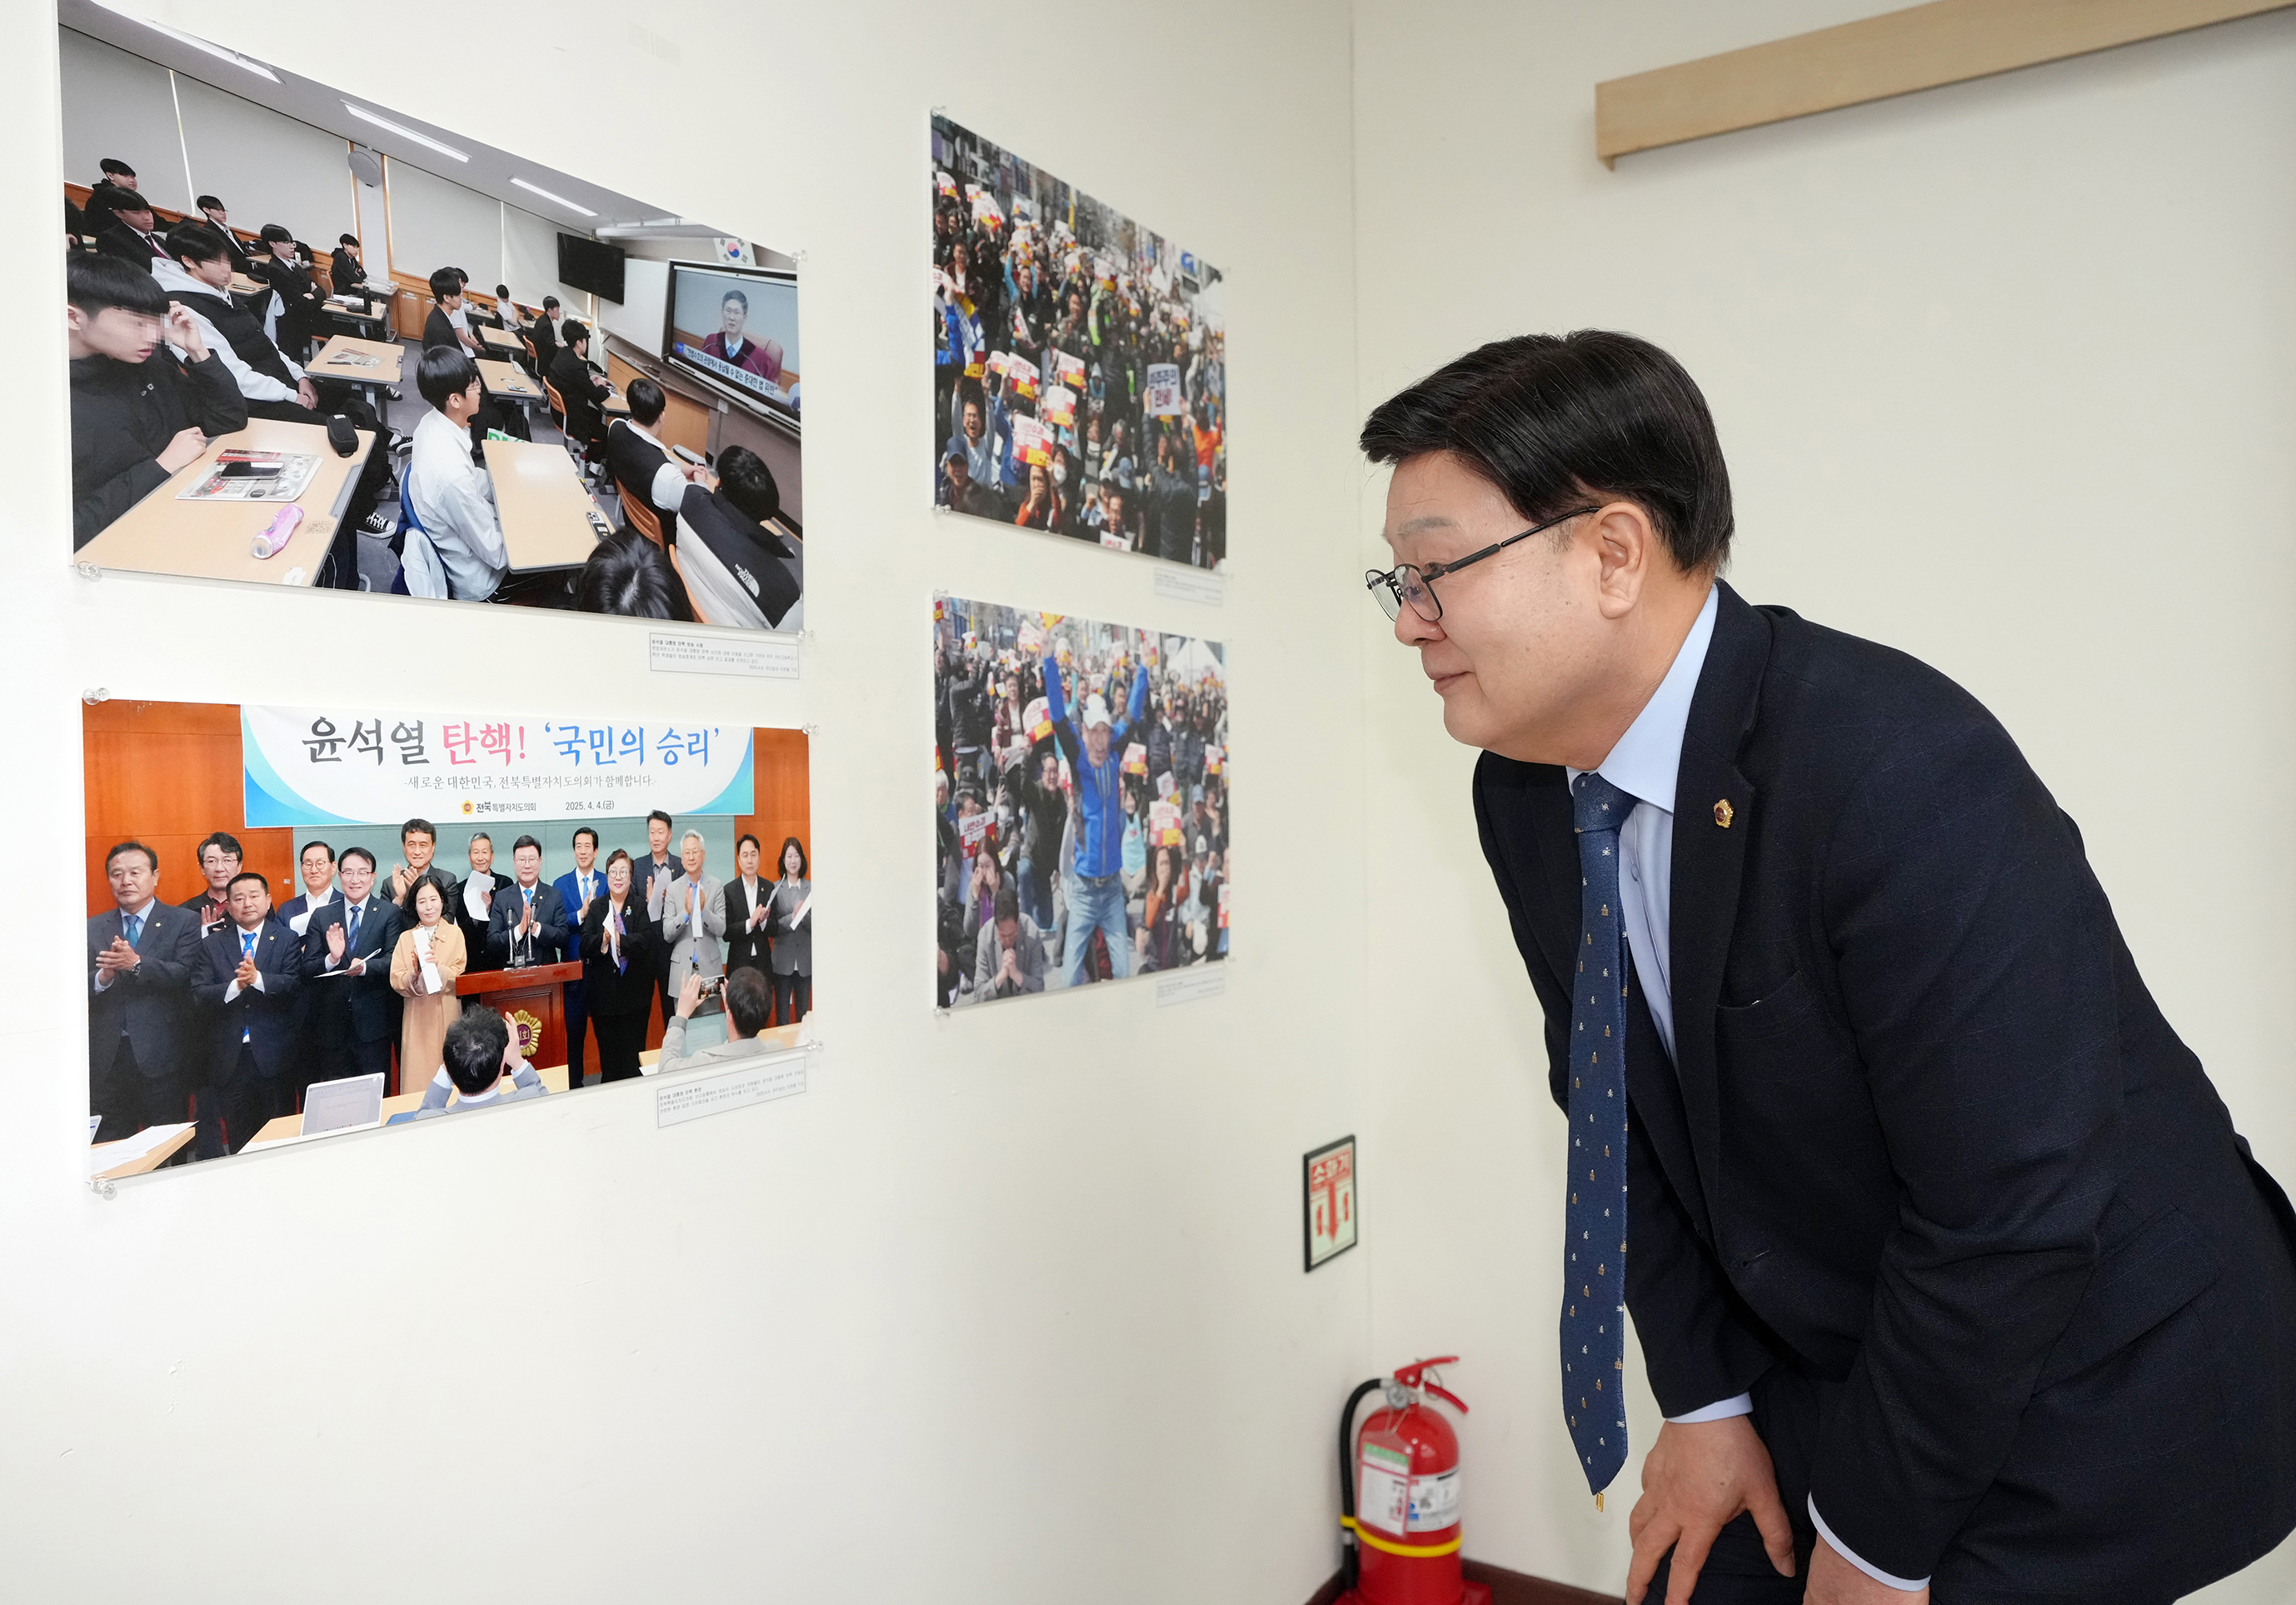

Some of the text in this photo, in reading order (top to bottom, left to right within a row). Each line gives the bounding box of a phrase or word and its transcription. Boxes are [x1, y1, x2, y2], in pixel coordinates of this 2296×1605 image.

[730, 367, 735, 376] 수
[735, 370, 744, 381] 없는
[744, 373, 758, 387] 중대한
[301, 715, 722, 768] 윤석열 탄핵! ‘국민의 승리’
[447, 775, 497, 790] 대한민국,
[499, 775, 604, 789] 전북특별자치도의회가
